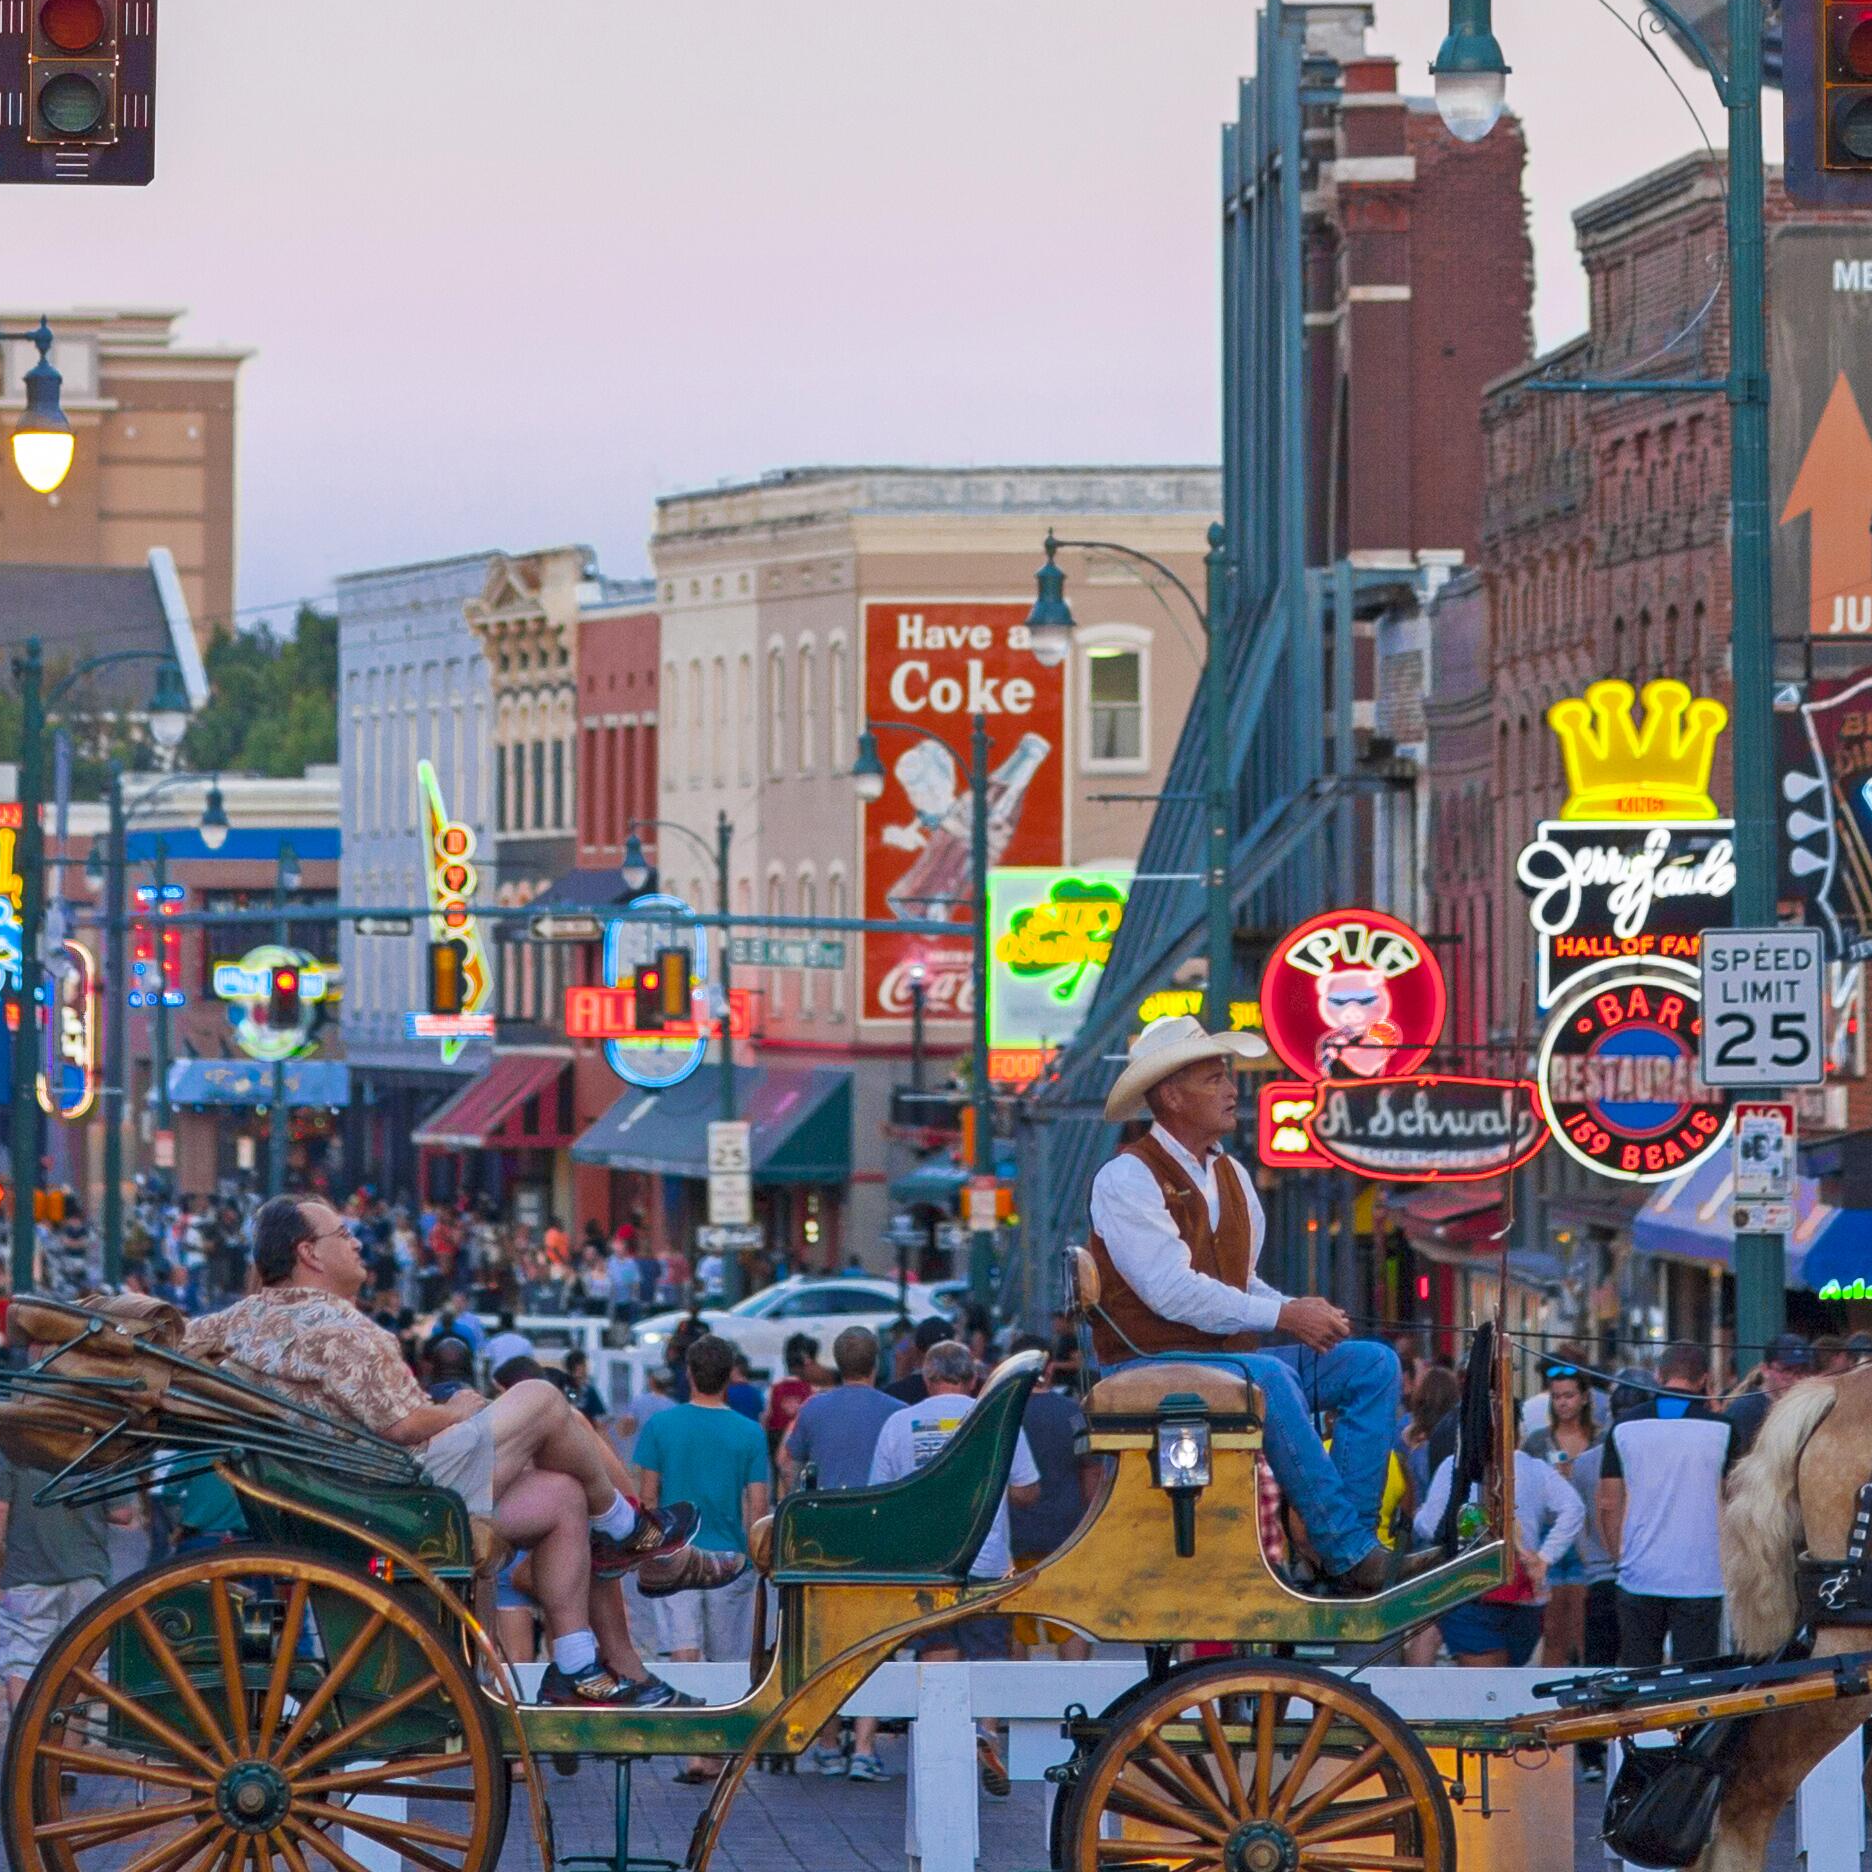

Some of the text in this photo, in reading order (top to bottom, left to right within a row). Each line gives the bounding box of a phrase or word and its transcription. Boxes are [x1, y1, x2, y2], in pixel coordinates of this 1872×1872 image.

[897, 614, 1029, 651] Have a
[889, 658, 1036, 716] Coke
[1517, 839, 1654, 940] Jerry
[1285, 923, 1421, 979] PIG
[1556, 936, 1621, 958] HALL
[1621, 935, 1655, 957] OF
[1711, 947, 1812, 973] SPEED
[1595, 986, 1685, 1030] BAR
[1722, 979, 1801, 1004] LIMIT
[1715, 1012, 1812, 1068] 25
[1550, 1054, 1725, 1105] RESTAURA
[1620, 1109, 1720, 1172] BEALE
